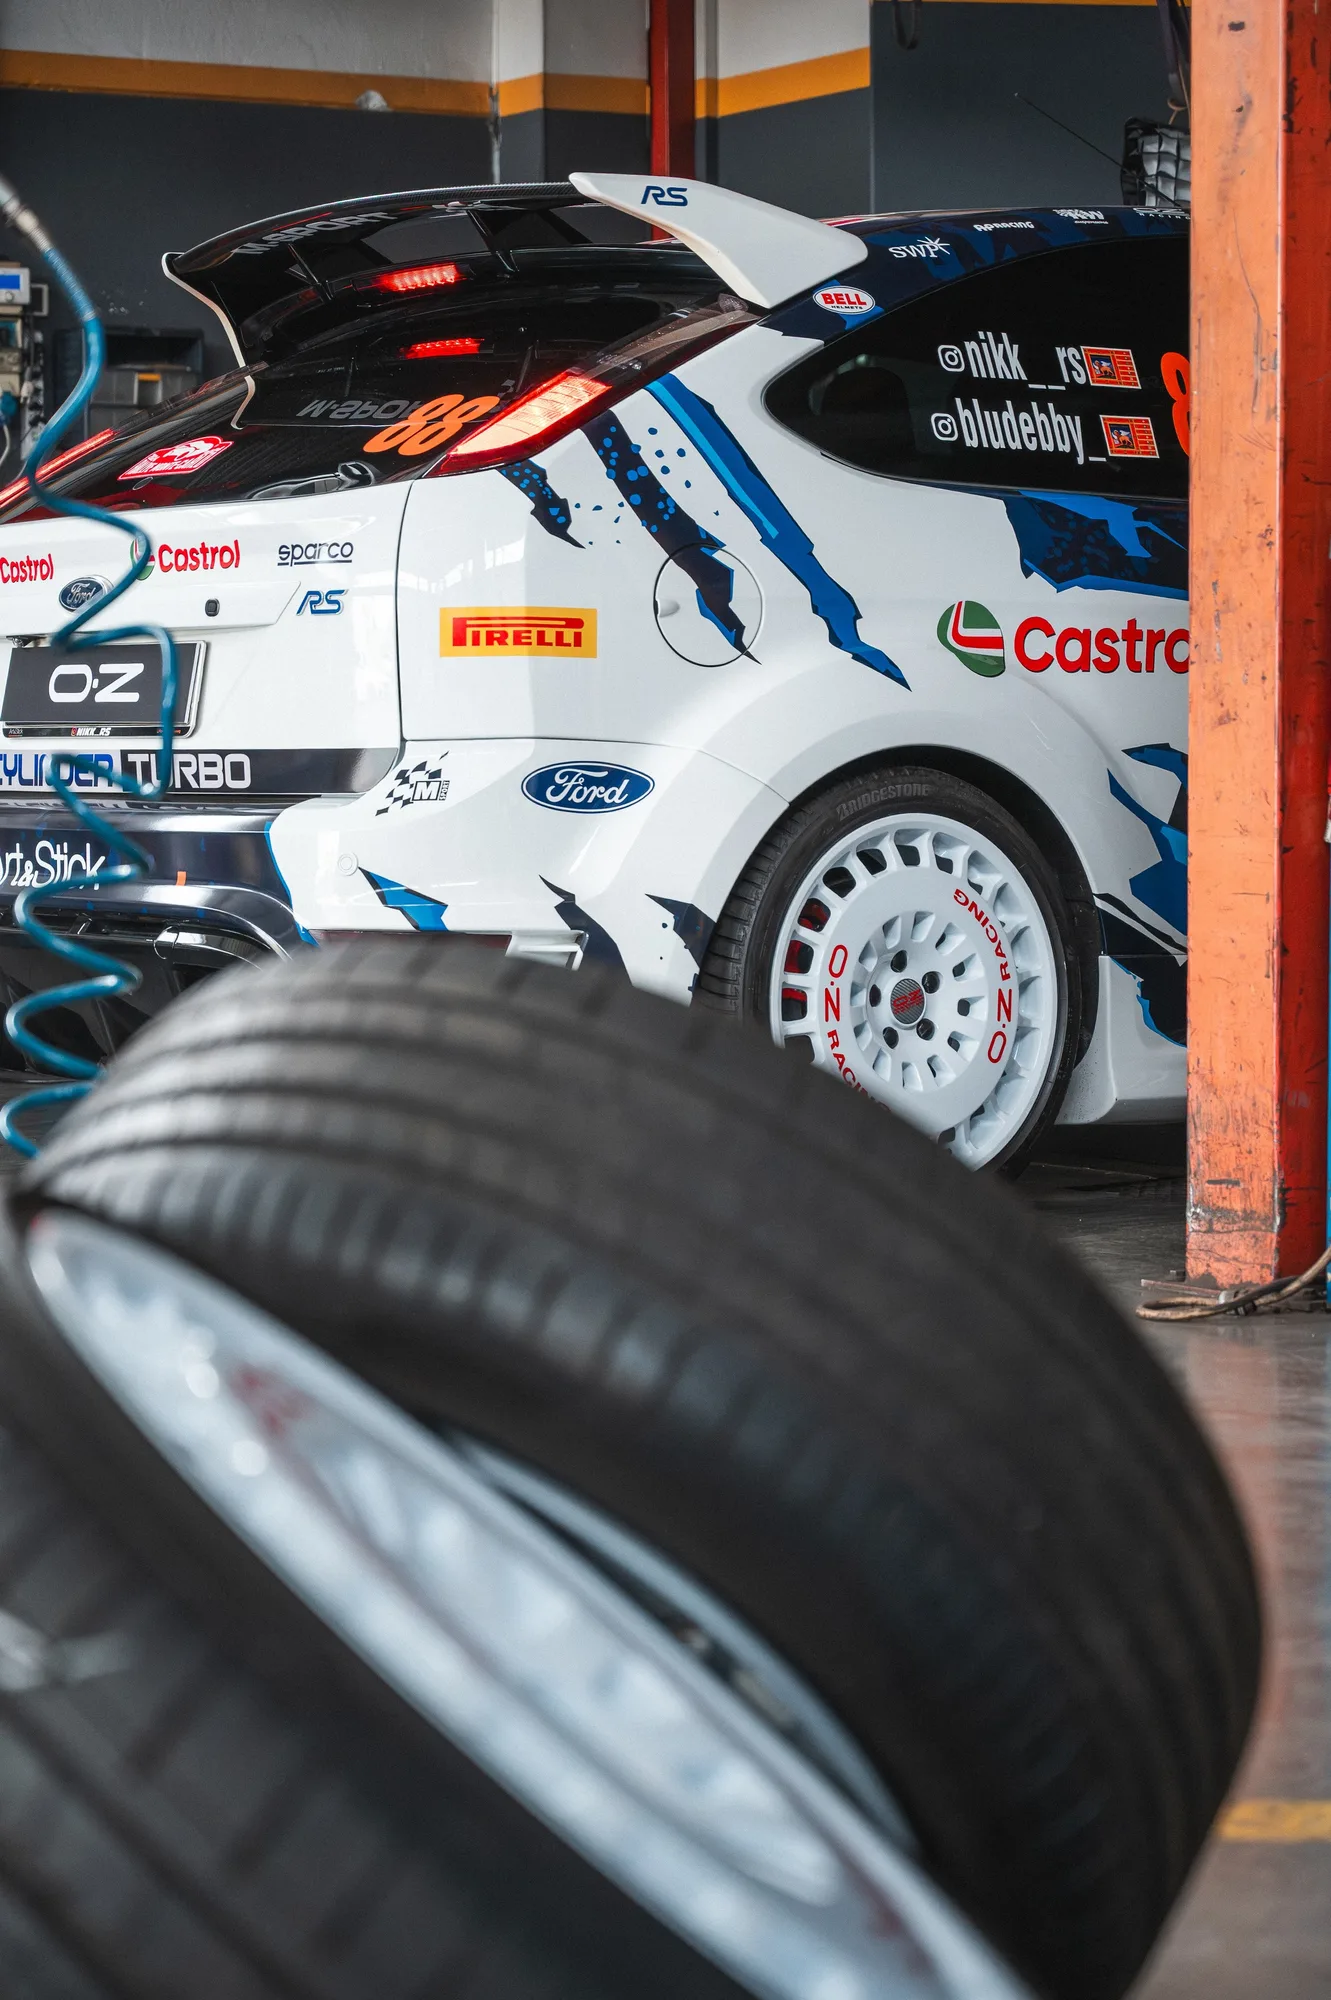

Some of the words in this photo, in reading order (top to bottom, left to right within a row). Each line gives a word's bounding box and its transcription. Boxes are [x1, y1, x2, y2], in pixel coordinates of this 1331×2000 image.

[641, 185, 688, 207] RS
[821, 292, 867, 306] BELL
[363, 393, 500, 456] 88
[0, 553, 54, 583] Castrol
[158, 539, 240, 573] Castrol
[278, 542, 353, 567] sparco
[66, 582, 96, 604] Ford
[296, 589, 348, 615] RS
[453, 617, 584, 647] PIRELLI
[1014, 616, 1190, 673] Castro
[0, 754, 113, 787] YLINDER
[127, 753, 251, 789] TURBO
[545, 768, 629, 804] Ford
[836, 783, 930, 821] BRIDGESTONE
[0, 840, 106, 890] rt&Stick
[953, 888, 1012, 981] RACING
